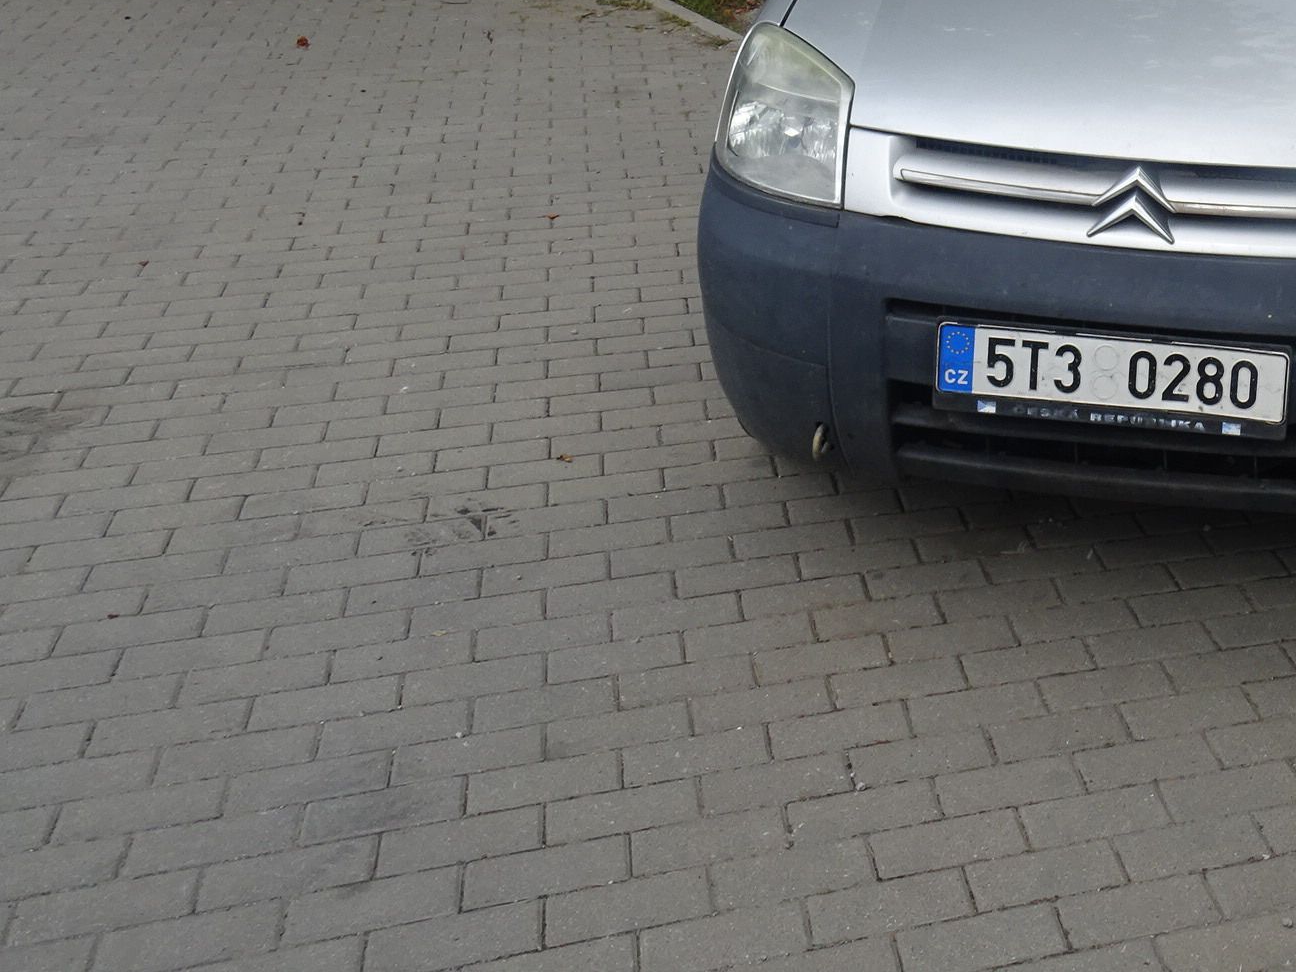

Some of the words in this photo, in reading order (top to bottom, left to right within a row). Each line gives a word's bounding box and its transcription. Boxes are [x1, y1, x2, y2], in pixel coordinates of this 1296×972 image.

[943, 368, 969, 386] CZ
[986, 336, 1083, 394] 5T3
[1128, 350, 1259, 410] 0280
